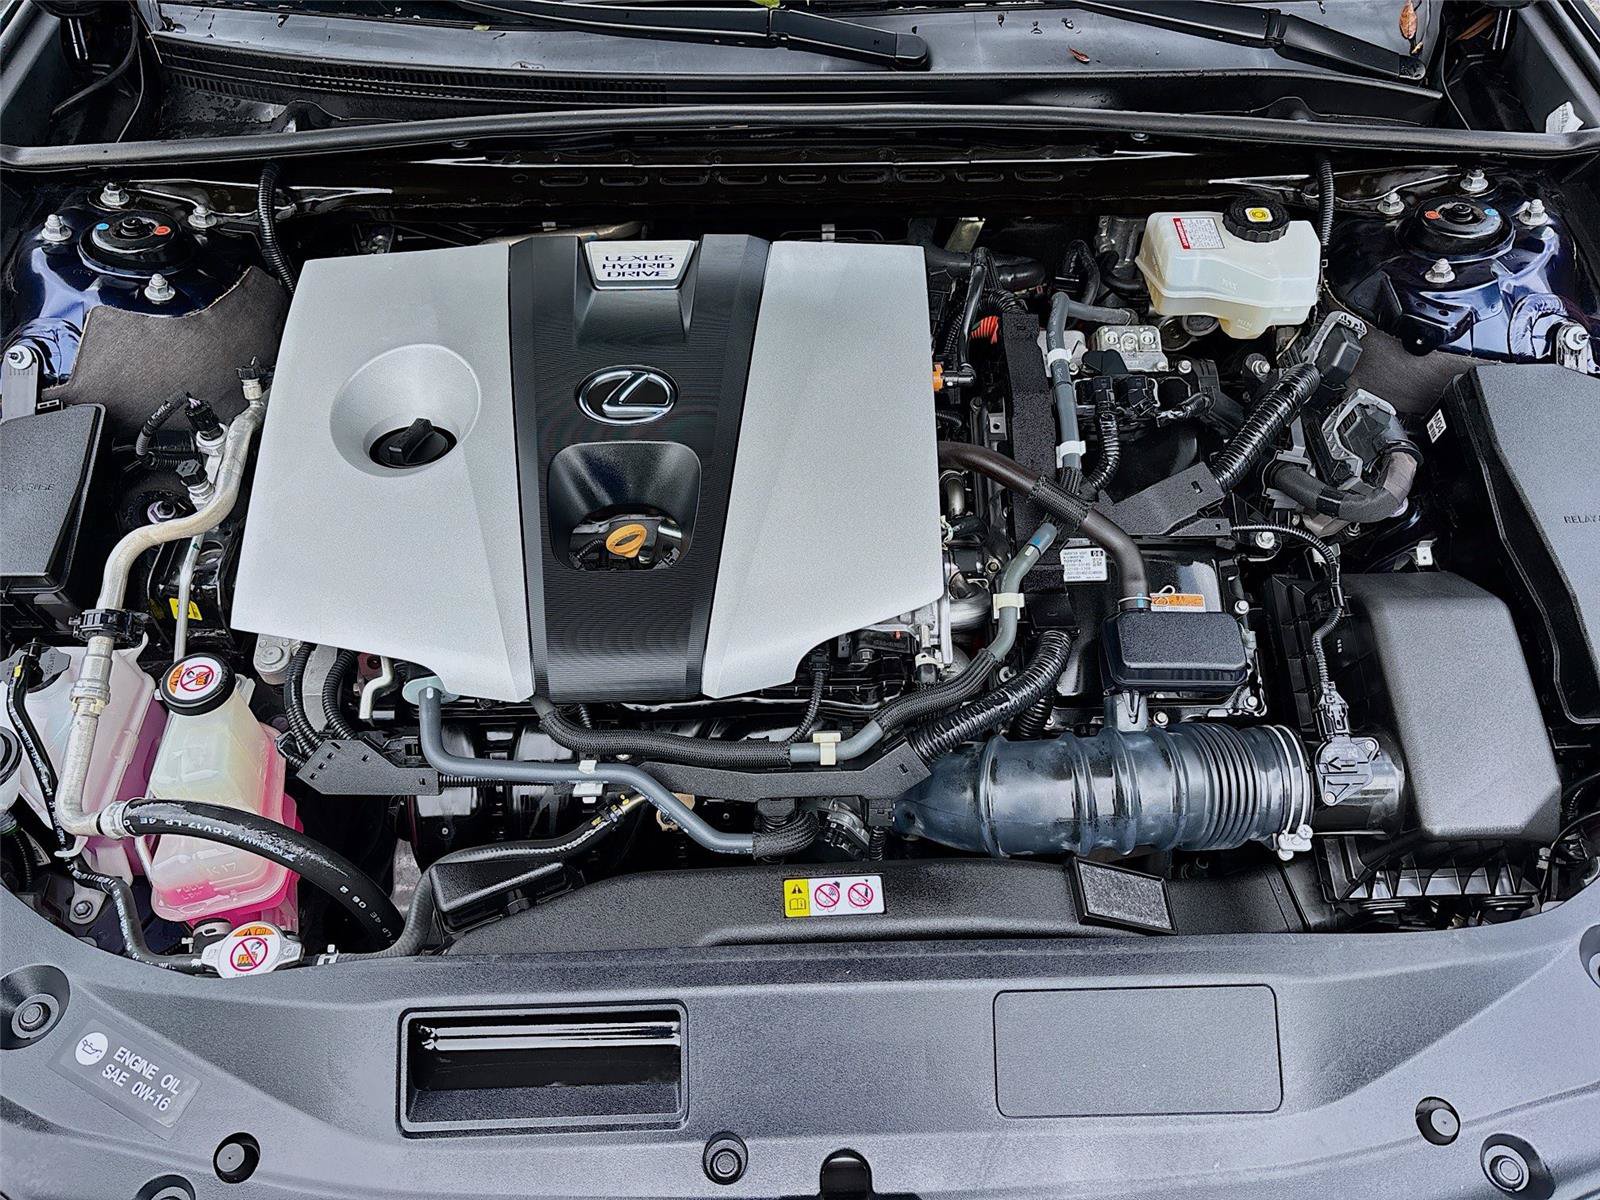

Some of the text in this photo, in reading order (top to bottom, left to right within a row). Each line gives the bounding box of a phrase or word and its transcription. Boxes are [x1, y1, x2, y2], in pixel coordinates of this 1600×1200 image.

[238, 834, 284, 858] YOKOHAMA
[101, 1063, 171, 1111] SAE 0W-16
[113, 1046, 181, 1096] ENGINE OIL
